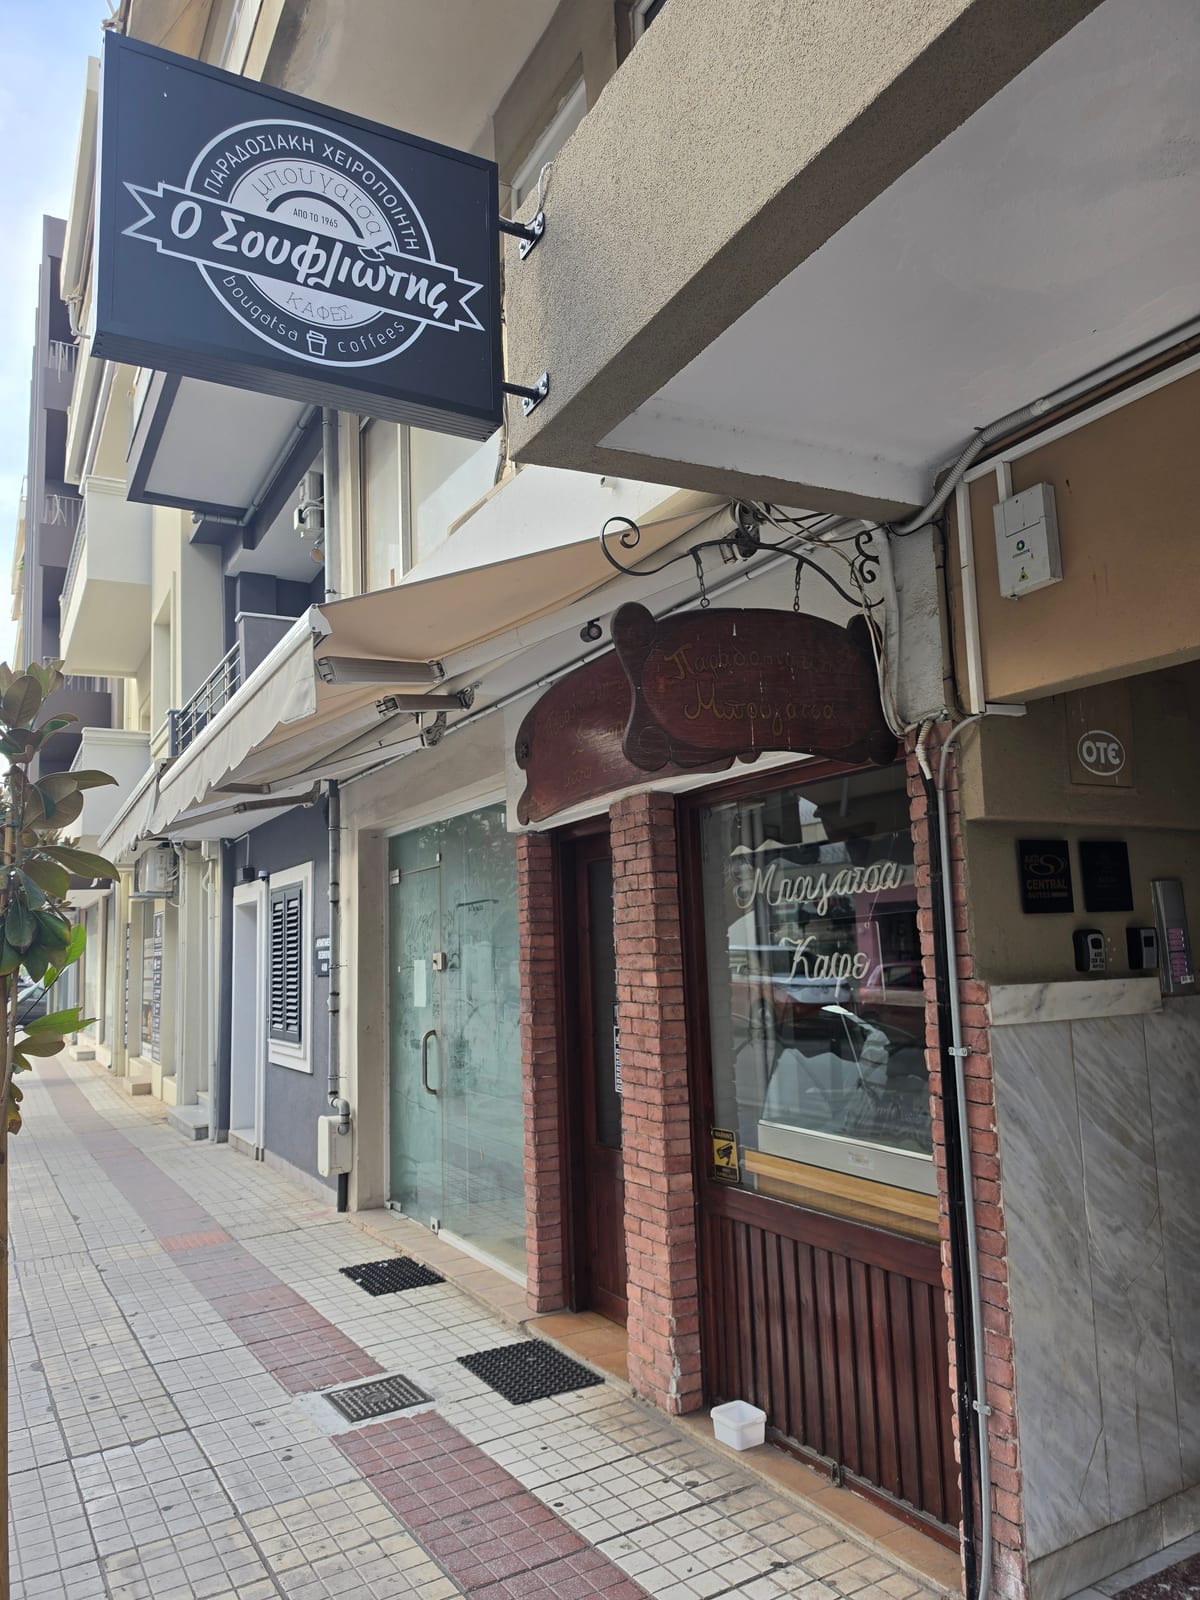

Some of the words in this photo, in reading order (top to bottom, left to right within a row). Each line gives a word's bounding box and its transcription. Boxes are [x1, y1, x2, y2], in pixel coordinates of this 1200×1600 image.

[203, 134, 314, 195] ΠΑΡΑΔΟΣΙΑΚΗ
[322, 143, 420, 250] ΧΕΙΡΟΠΟΙΗΤΗ
[170, 200, 202, 239] Ο
[293, 208, 308, 220] ΑΠΟ
[310, 212, 319, 223] ΤΟ
[321, 215, 339, 229] 1965
[222, 274, 299, 342] bougatsa
[337, 321, 405, 353] coffees
[286, 291, 353, 322] ΚΑΦΕΣ
